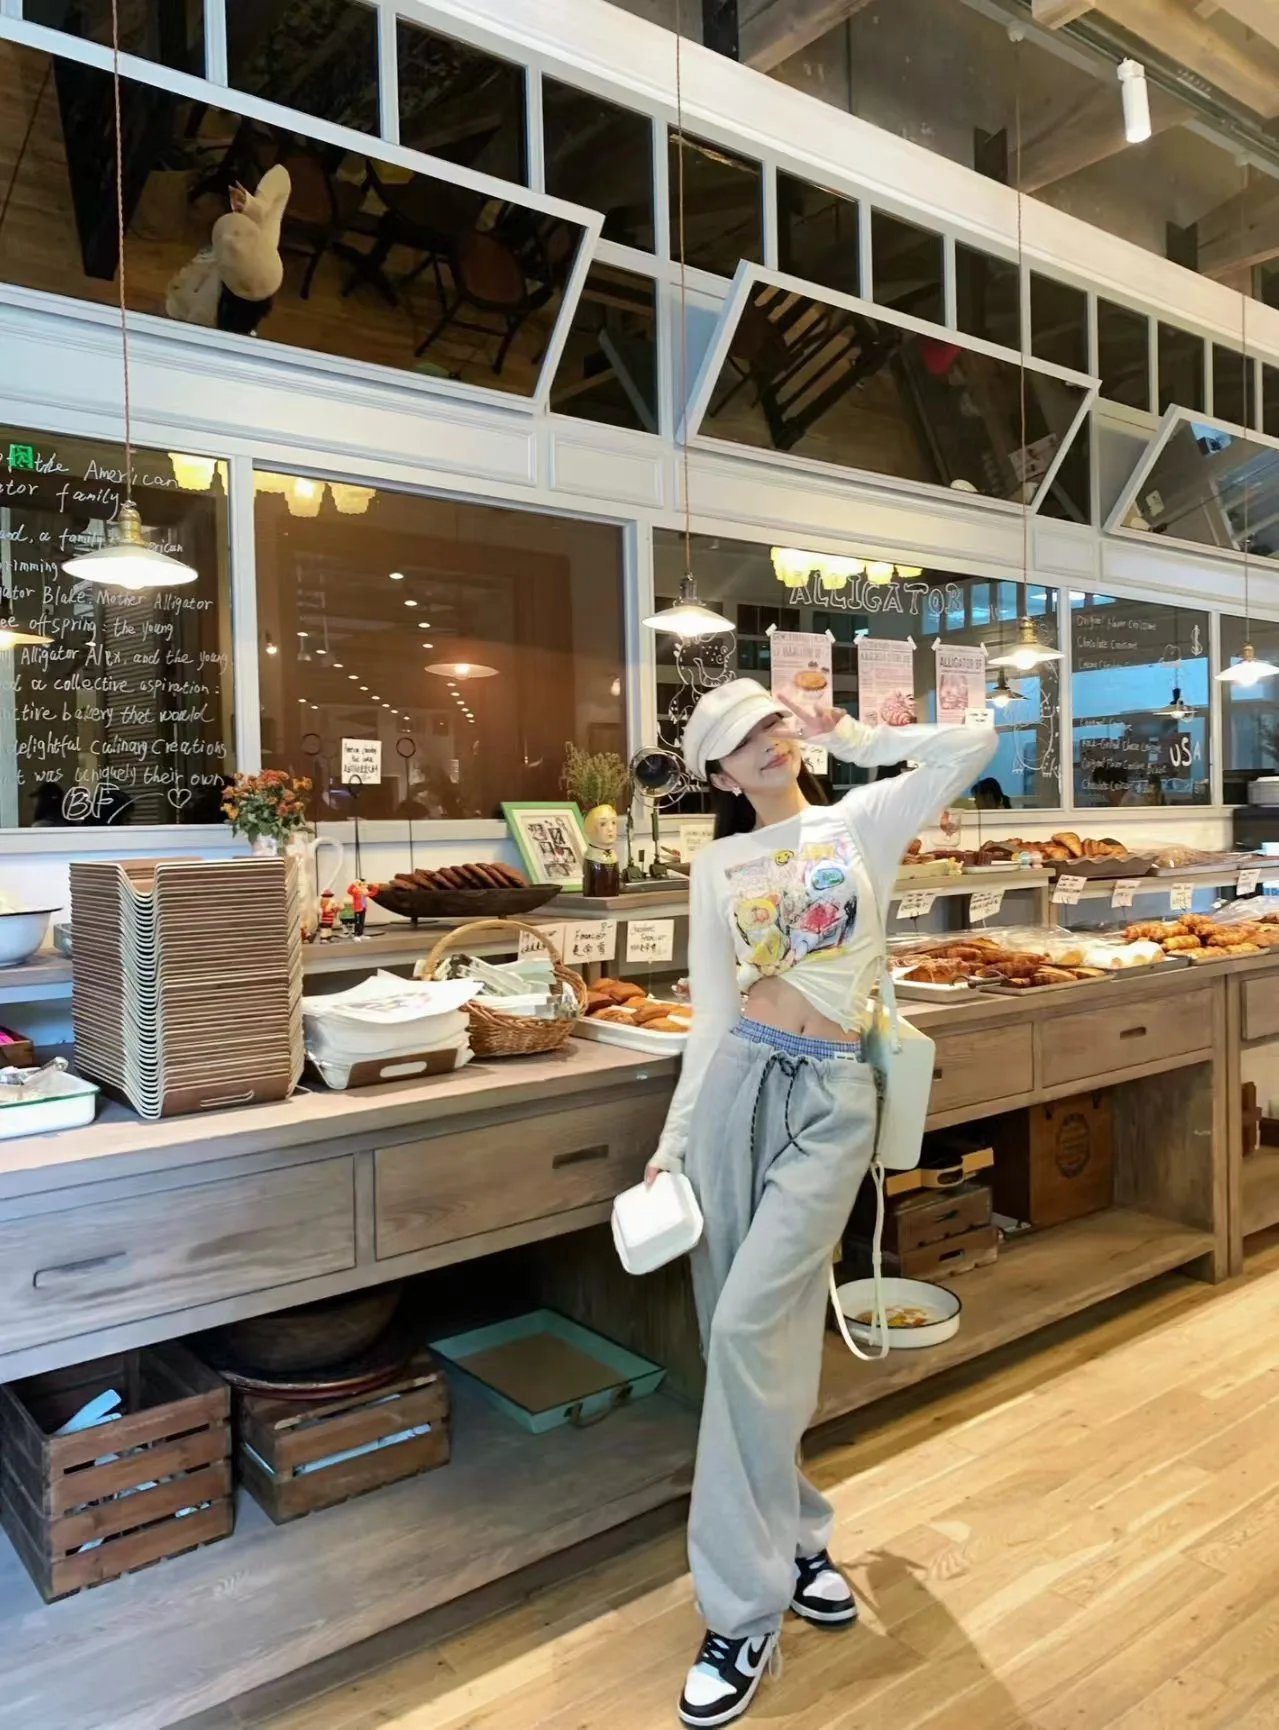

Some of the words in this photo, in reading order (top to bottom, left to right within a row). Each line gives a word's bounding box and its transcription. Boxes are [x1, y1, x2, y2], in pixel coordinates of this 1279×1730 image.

[83, 459, 178, 489] American
[56, 483, 119, 521] family
[39, 532, 51, 541] a
[97, 589, 146, 606] Mother
[153, 592, 213, 616] Alligator
[789, 571, 963, 615] ALLIGATOR
[113, 618, 136, 637] the
[142, 620, 174, 641] young
[21, 646, 80, 672] Alligator
[133, 649, 160, 665] and
[166, 649, 194, 664] the
[197, 651, 229, 676] young
[31, 679, 47, 691] a
[54, 673, 135, 693] collective
[62, 701, 113, 728] bakery
[120, 705, 155, 725] that
[160, 703, 215, 723] would
[1169, 736, 1201, 767] USA
[34, 769, 64, 782] was
[75, 764, 136, 788] uniquely
[144, 767, 184, 786] their
[190, 773, 225, 786] own
